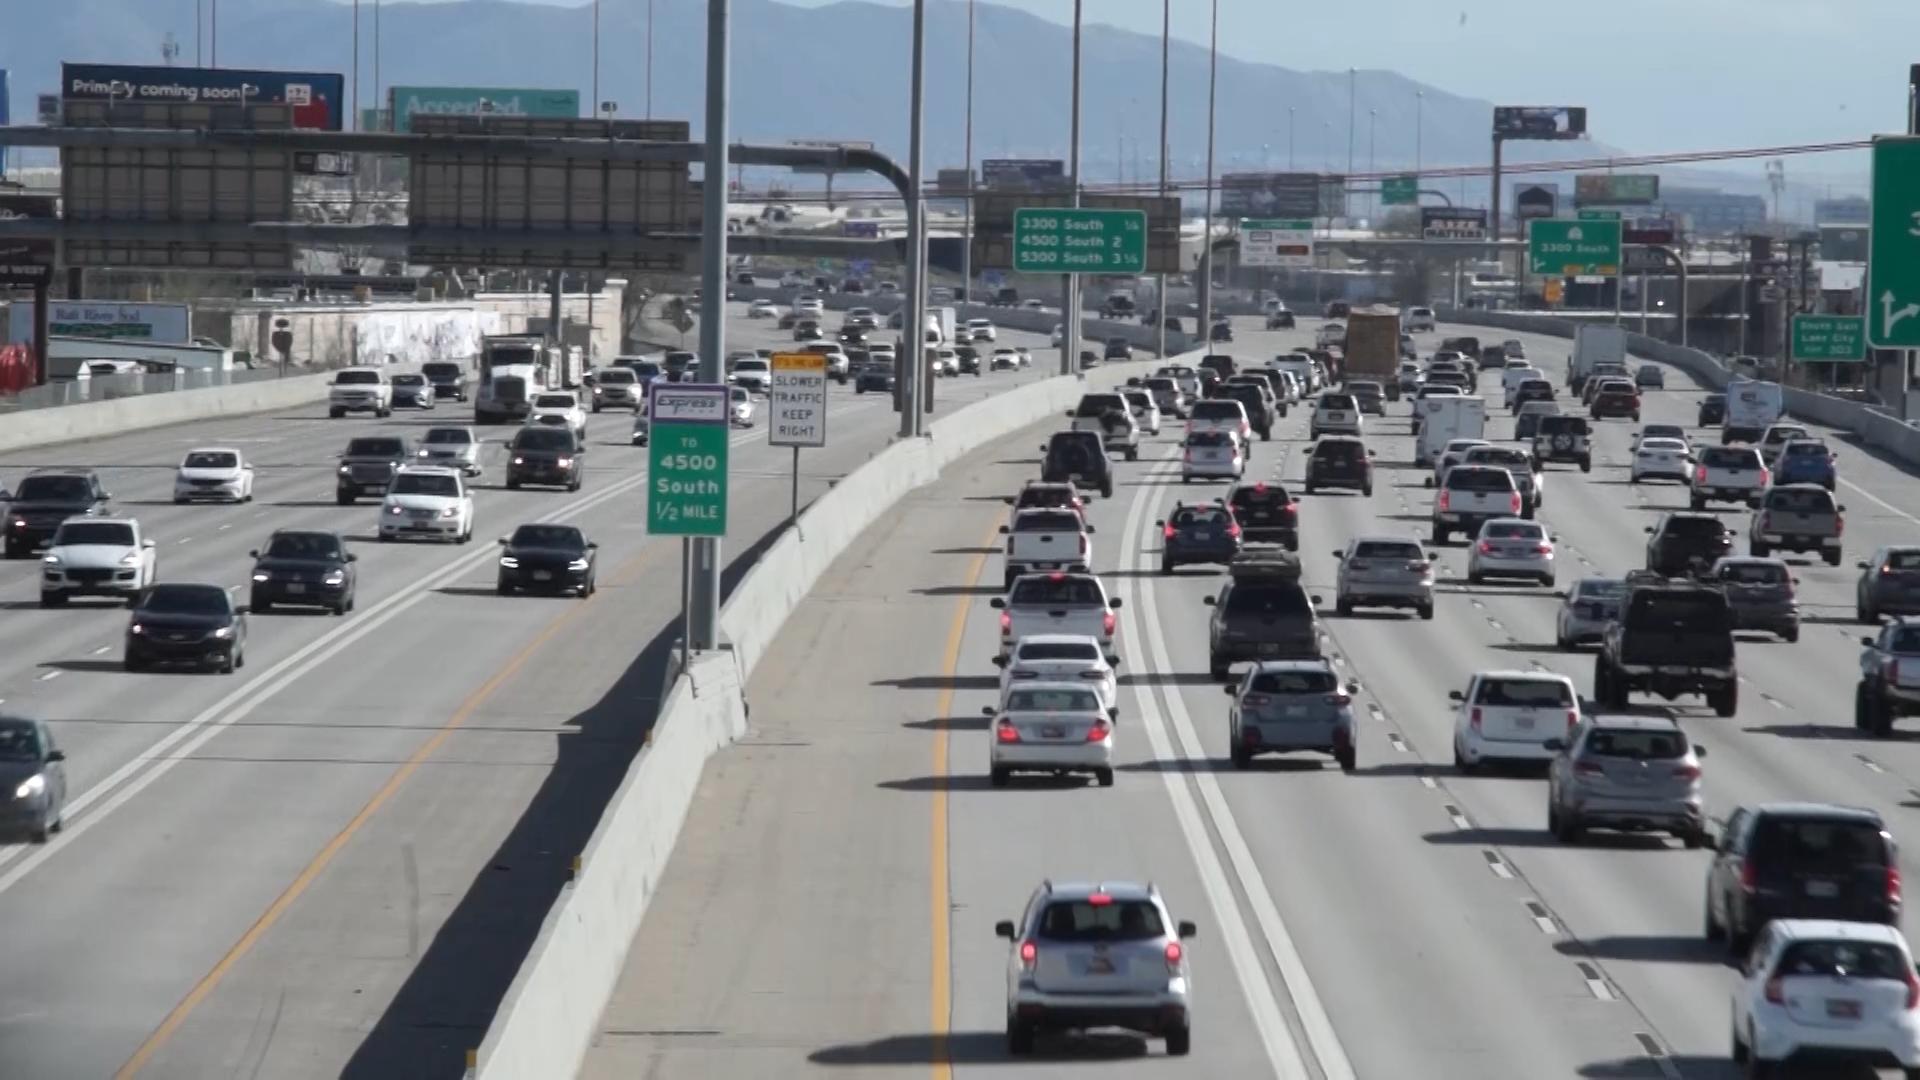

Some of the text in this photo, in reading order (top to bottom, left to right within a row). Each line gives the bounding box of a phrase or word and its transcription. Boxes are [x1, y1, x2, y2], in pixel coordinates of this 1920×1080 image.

[72, 80, 241, 100] Primy coming soon
[1021, 217, 1058, 230] 3300
[1063, 219, 1104, 231] South
[1020, 235, 1121, 248] 4500 South 2
[1575, 244, 1610, 253] South
[1021, 251, 1057, 263] 5300
[1063, 252, 1103, 264] South
[1112, 253, 1121, 264] 3
[775, 375, 822, 388] SLOWER
[657, 395, 717, 414] Express
[775, 392, 822, 404] TRAFFIC
[782, 409, 813, 420] KEEP
[779, 425, 815, 437] RIGHT
[681, 437, 698, 448] TO
[660, 454, 717, 471] 4500
[657, 478, 719, 494] South
[683, 504, 719, 519] MILE
